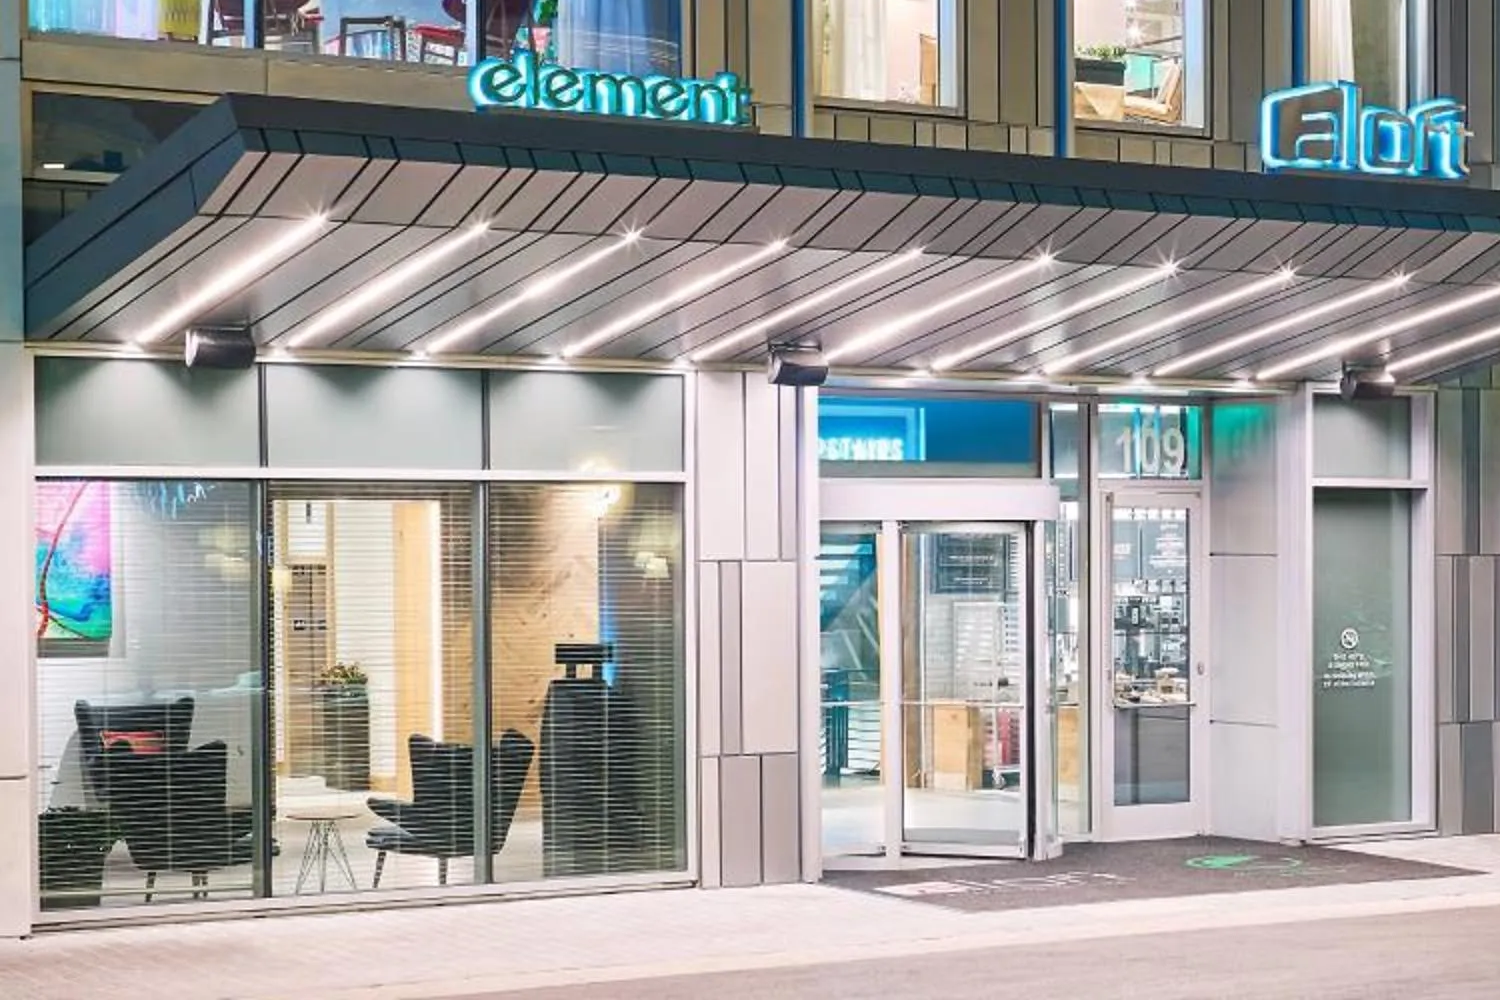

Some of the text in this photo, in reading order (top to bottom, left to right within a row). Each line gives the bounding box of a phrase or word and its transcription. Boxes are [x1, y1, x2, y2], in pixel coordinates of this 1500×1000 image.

[469, 48, 752, 125] element
[1261, 79, 1474, 178] aloft
[1115, 426, 1185, 475] 109
